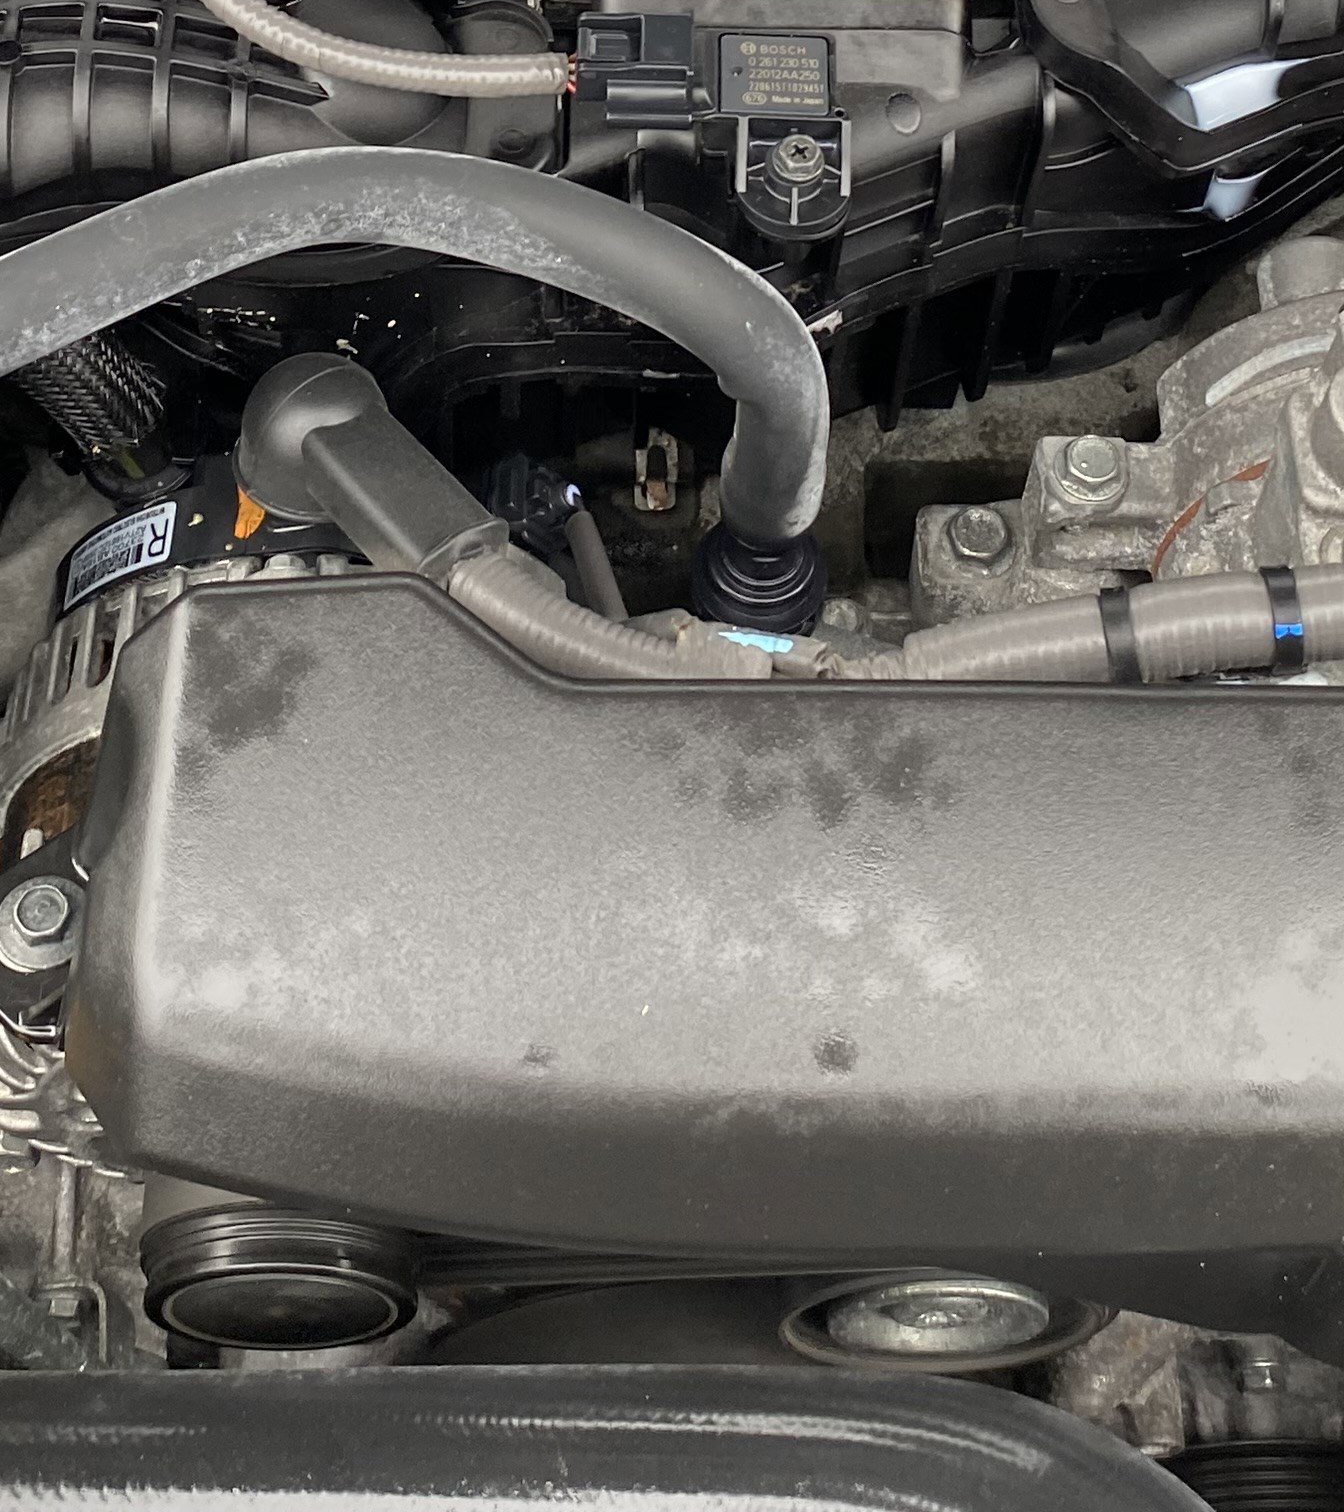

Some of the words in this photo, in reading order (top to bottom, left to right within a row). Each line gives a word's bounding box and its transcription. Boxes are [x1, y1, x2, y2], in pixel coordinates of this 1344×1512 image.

[760, 44, 806, 54] BOSCH
[759, 57, 777, 67] 261
[780, 58, 799, 67] 230
[801, 58, 819, 68] 510
[749, 69, 820, 80] 22012AA250
[147, 517, 169, 558] R
